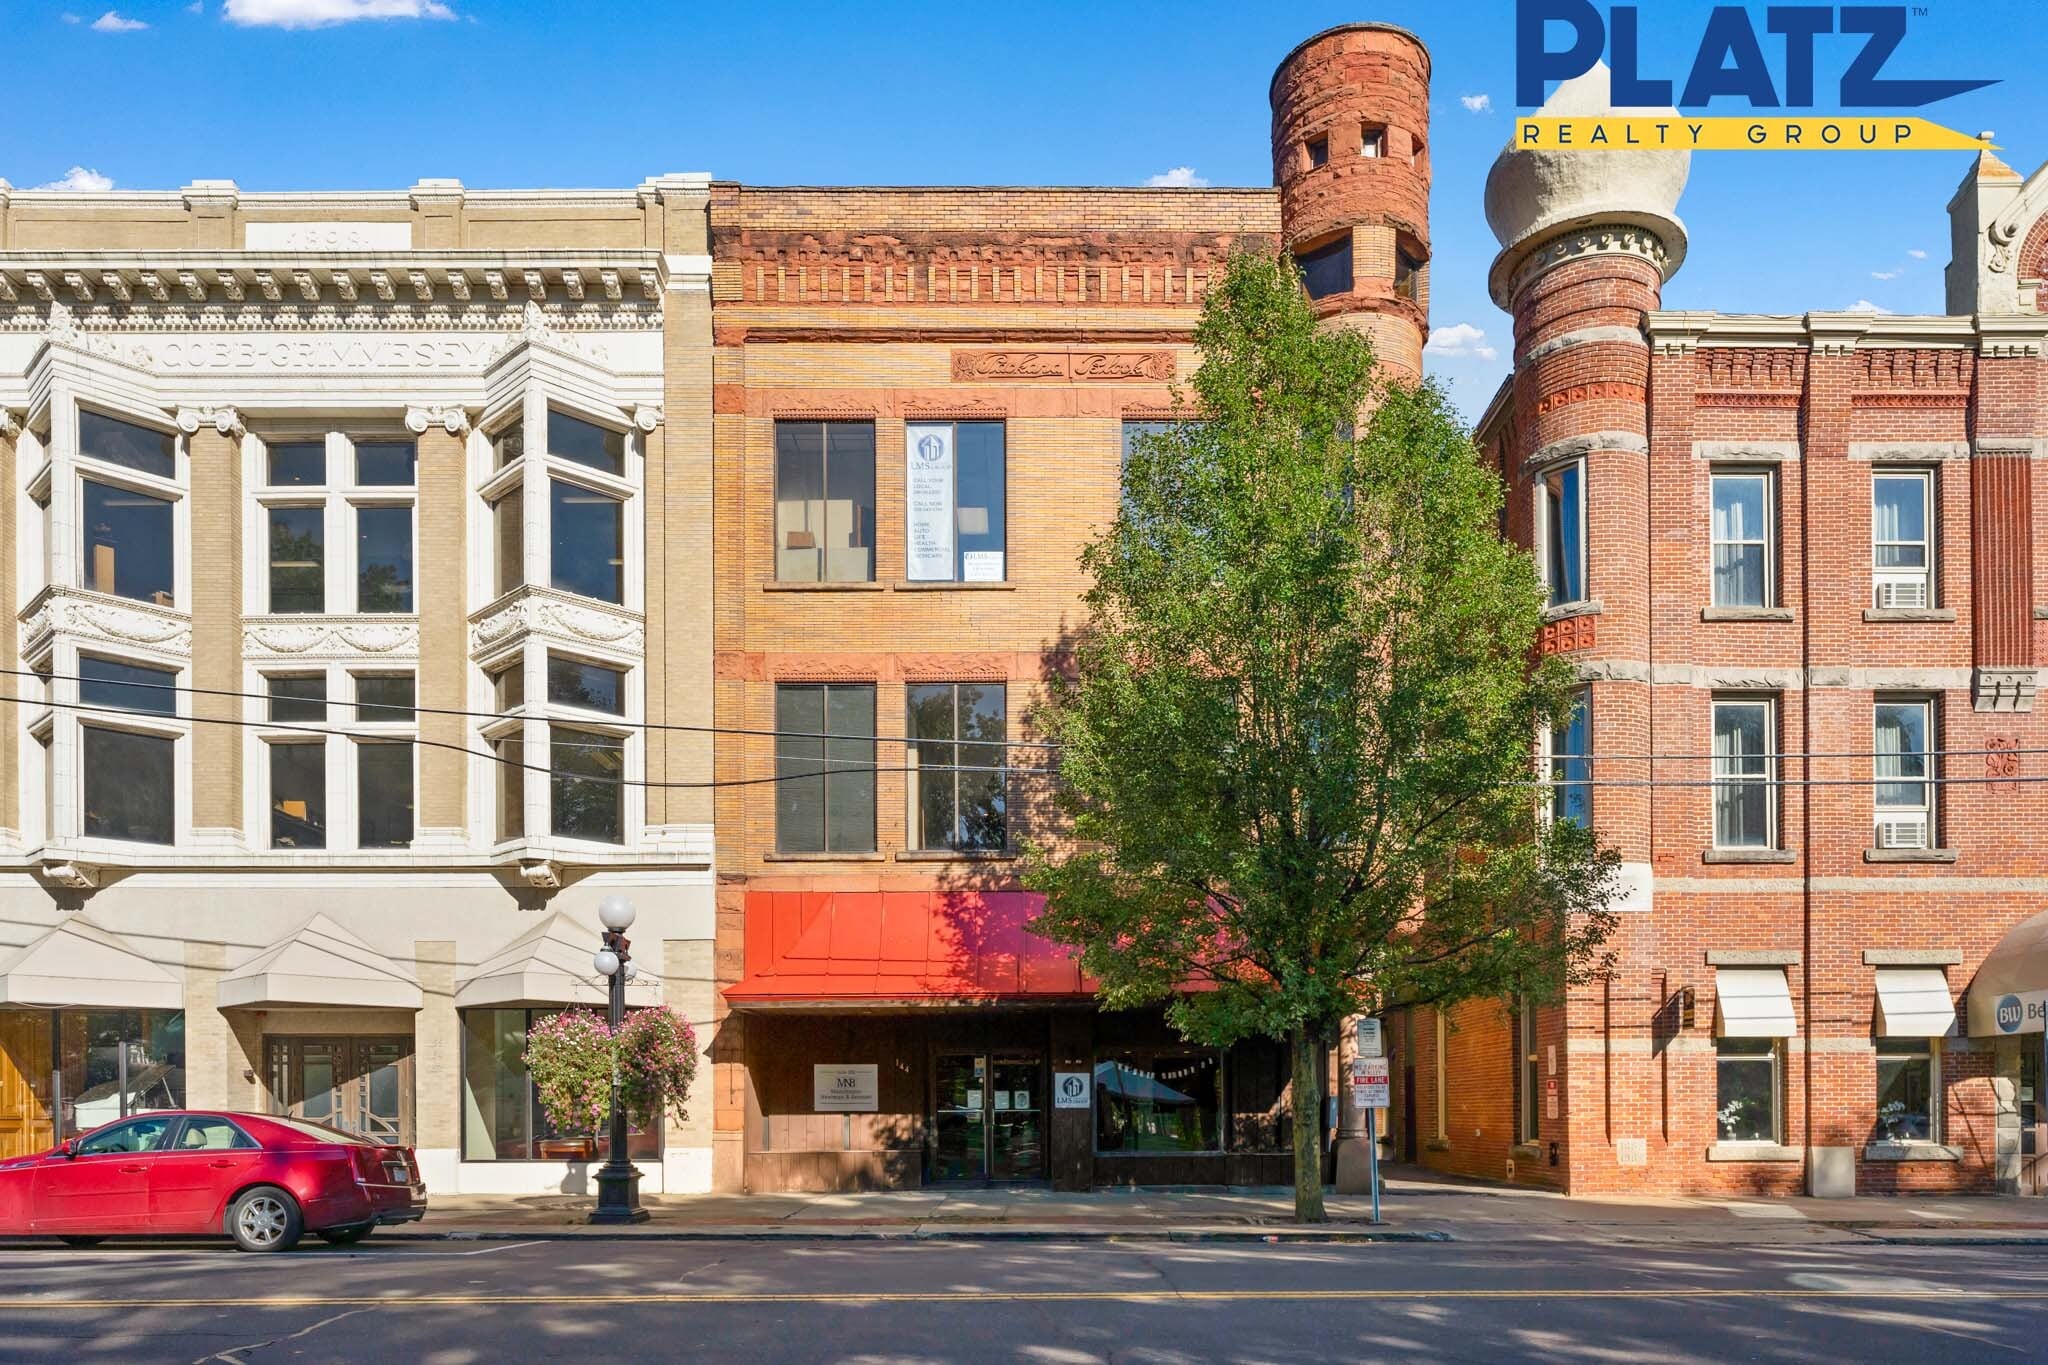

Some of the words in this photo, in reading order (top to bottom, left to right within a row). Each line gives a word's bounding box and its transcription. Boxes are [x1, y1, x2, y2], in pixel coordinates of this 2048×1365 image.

[1075, 354, 1153, 376] Block
[1999, 1006, 2021, 1024] BW
[1056, 1096, 1073, 1104] LMS
